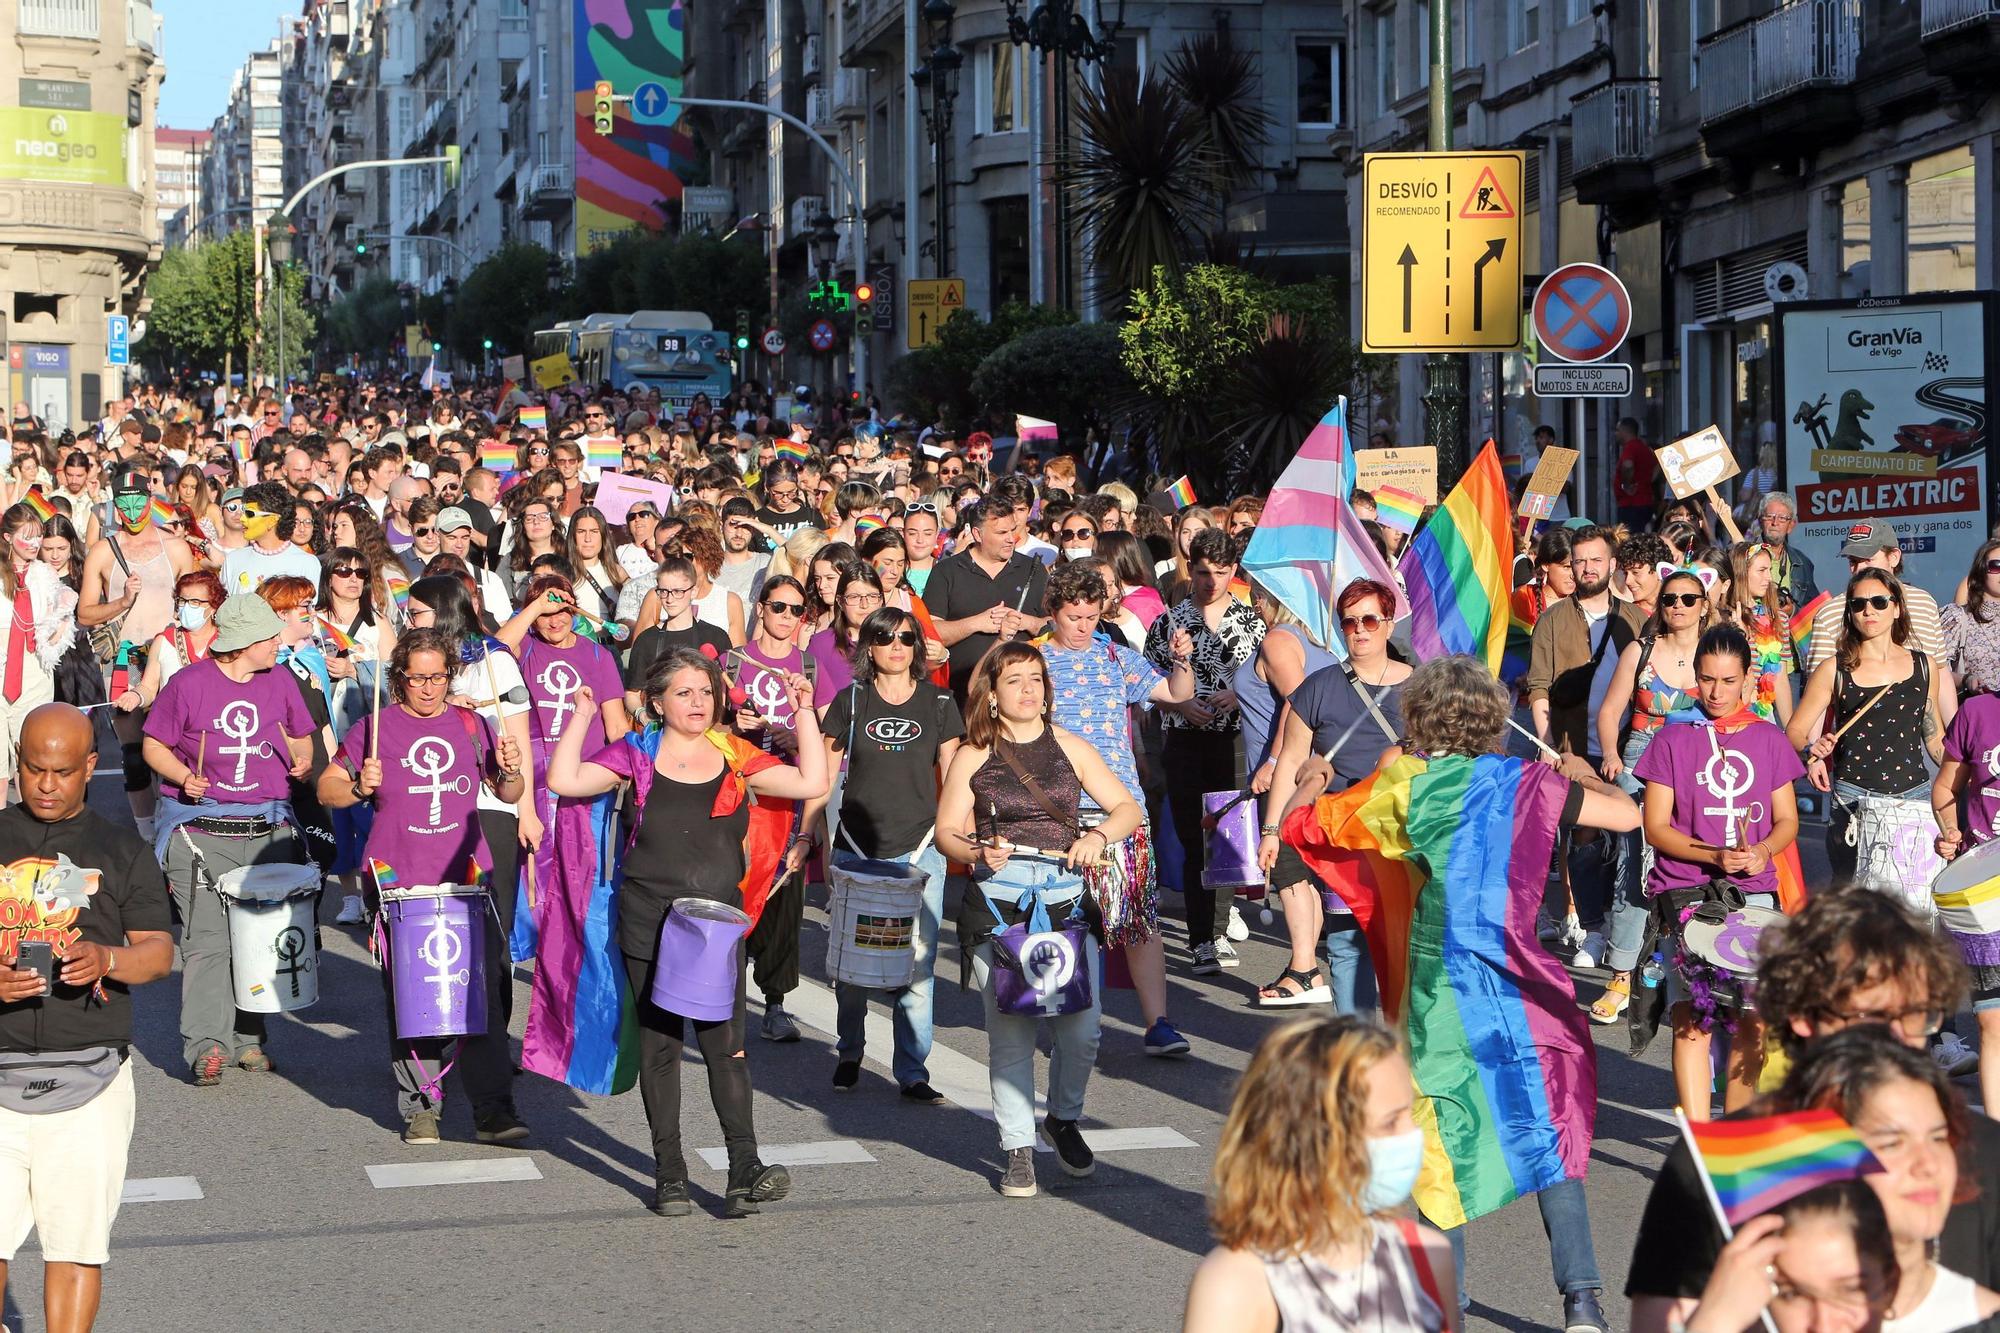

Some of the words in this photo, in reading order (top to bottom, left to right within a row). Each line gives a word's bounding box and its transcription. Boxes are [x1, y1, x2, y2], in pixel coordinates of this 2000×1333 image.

[15, 138, 97, 162] neogeo
[1380, 177, 1438, 199] DESVÍO
[1376, 206, 1441, 216] RECOMENDADO
[1856, 298, 1901, 308] JCDecaux
[113, 320, 124, 341] P
[766, 335, 784, 346] 40
[1847, 327, 1922, 348] GranVía
[36, 351, 60, 362] VIGO
[1869, 348, 1880, 357] de
[1882, 347, 1902, 358] Vigo
[1562, 369, 1602, 380] INCLUSO
[1540, 381, 1573, 391] MOTOS
[1576, 381, 1589, 391] EN
[1592, 381, 1624, 391] ACERA
[1384, 450, 1399, 459] LA
[1820, 454, 1904, 471] CAMPEONATO
[1908, 458, 1926, 472] DE
[1810, 477, 1966, 516] SCALEXTRIC
[1804, 525, 1850, 537] Inscribe
[1914, 523, 1923, 533] y
[1924, 521, 1950, 534] gana
[1952, 518, 1973, 530] dos
[1917, 539, 1925, 551] 5
[875, 720, 912, 739] GZ
[0, 898, 41, 929] OM
[28, 1078, 58, 1091] NIKE
